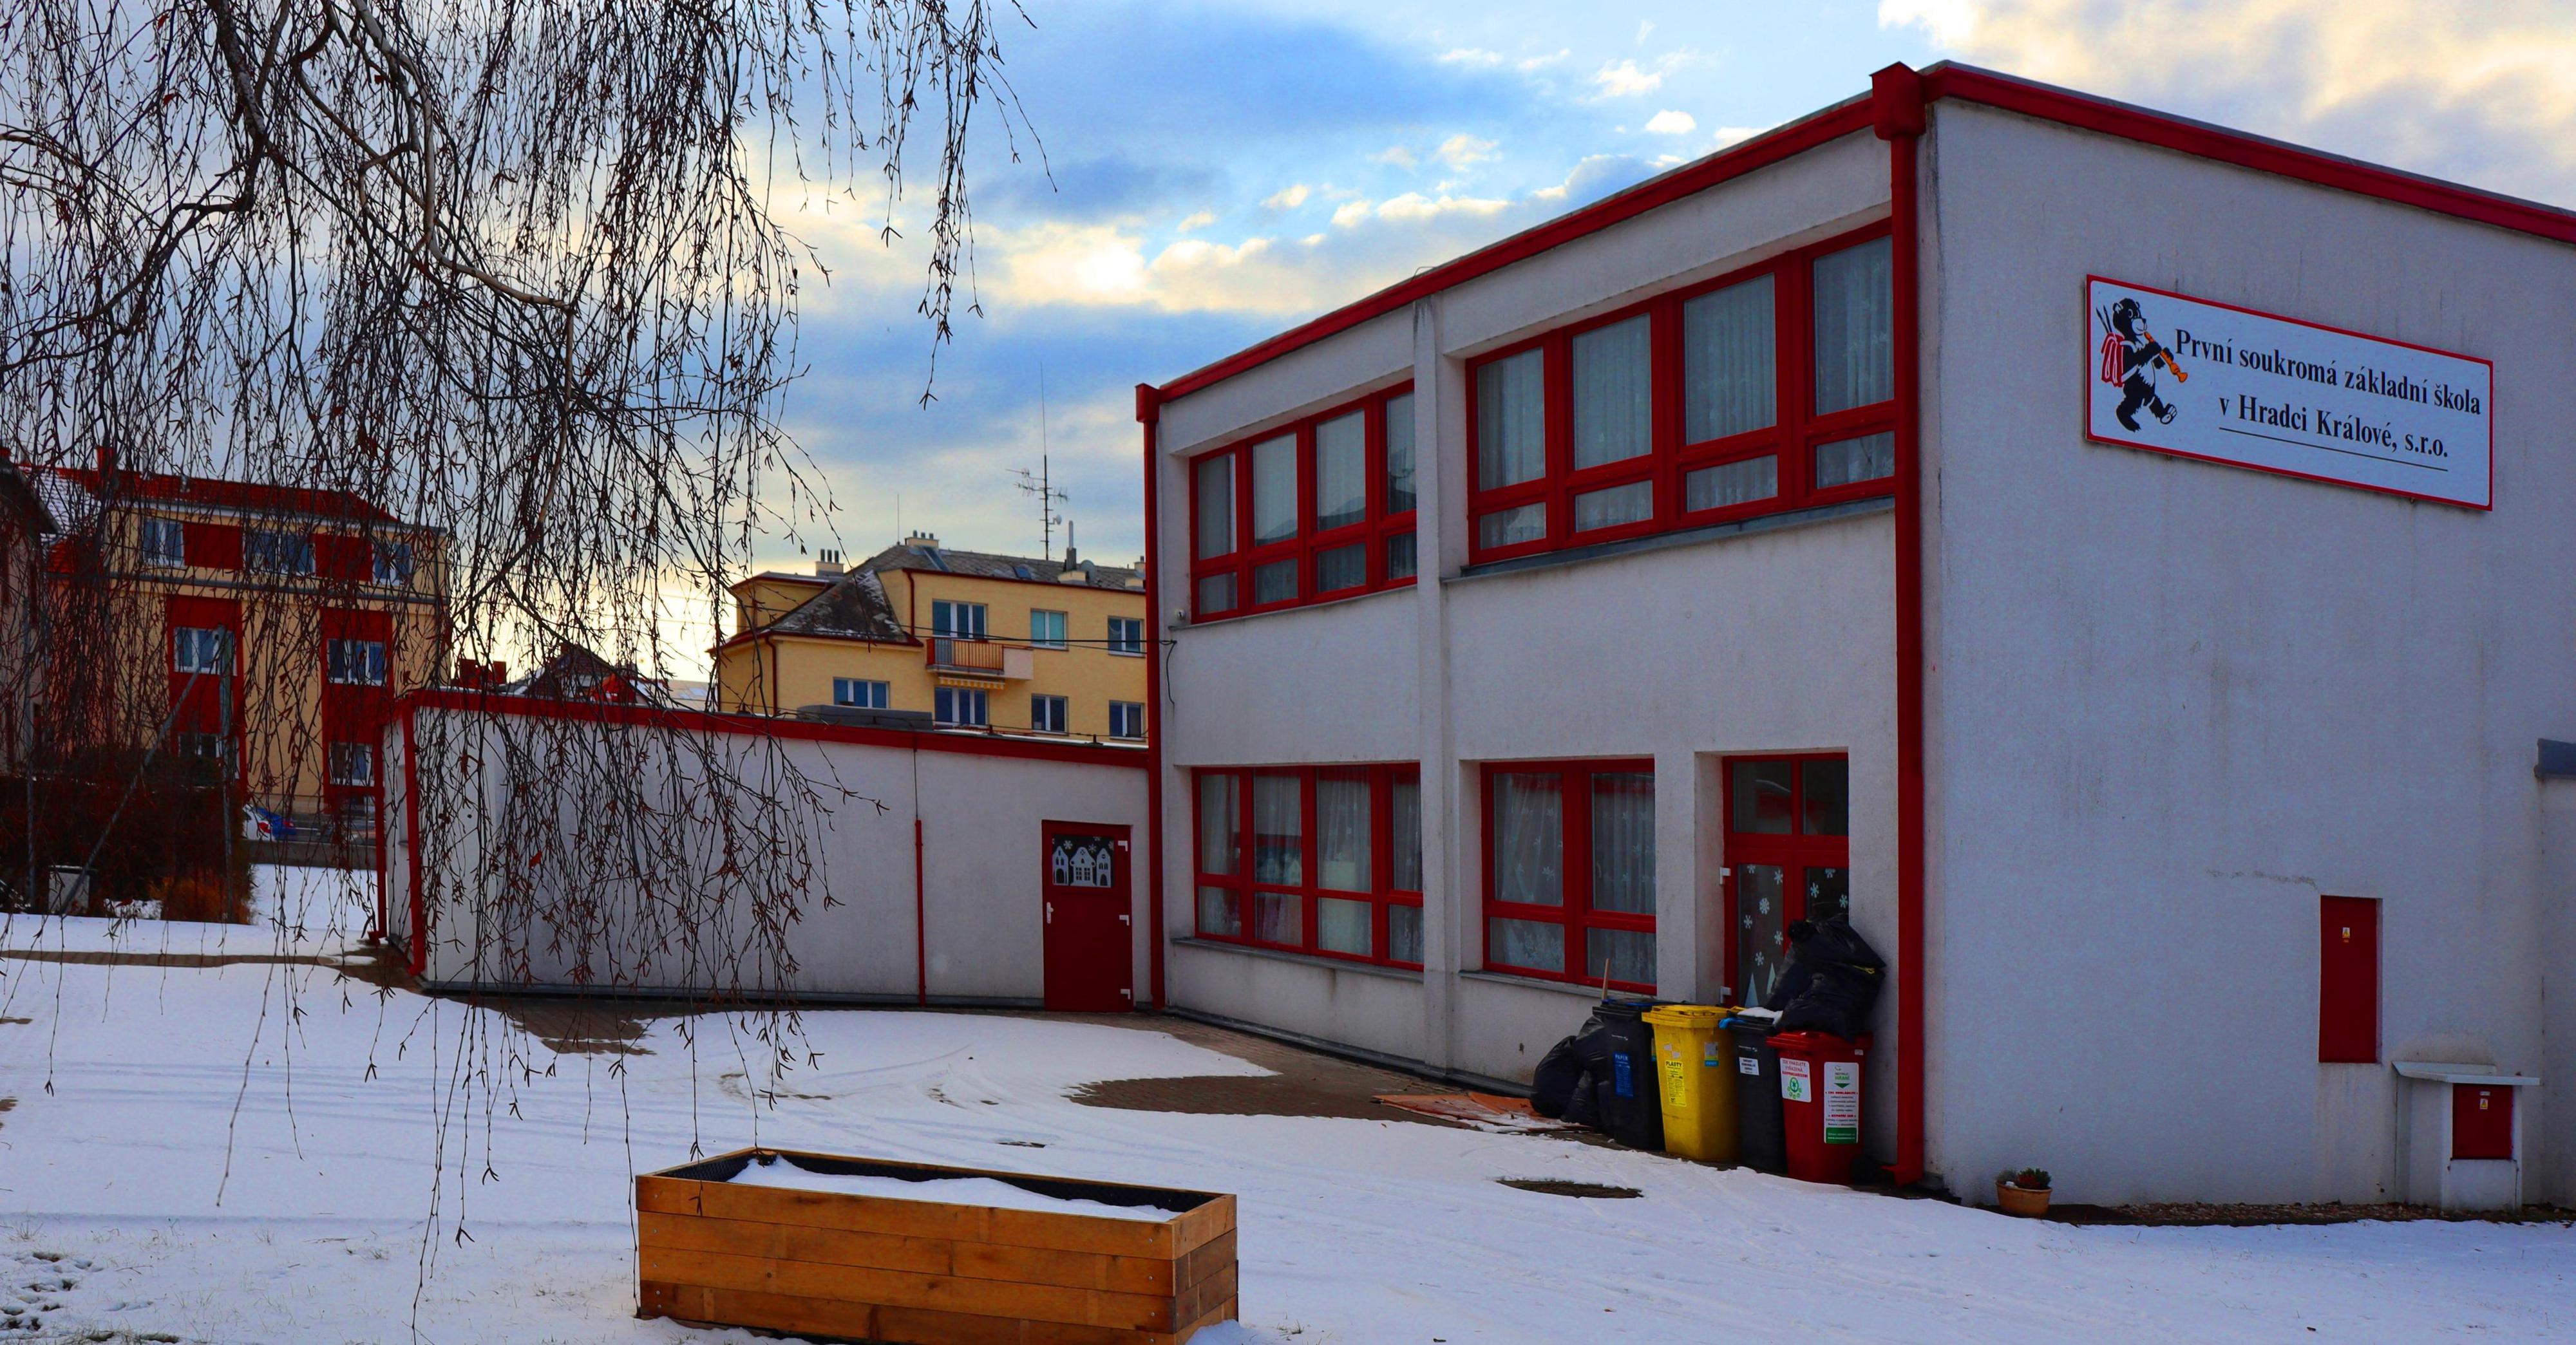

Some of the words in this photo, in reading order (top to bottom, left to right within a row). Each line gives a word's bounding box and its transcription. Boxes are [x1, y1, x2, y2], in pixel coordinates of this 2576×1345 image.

[2175, 328, 2233, 364] První
[2239, 349, 2338, 386] soukromá
[2344, 366, 2429, 405] základní
[2434, 383, 2481, 416] škola
[2219, 397, 2230, 416] v
[2239, 394, 2307, 432] Hradci
[2316, 409, 2398, 453] Králové,
[2405, 433, 2448, 458] s.r.o.
